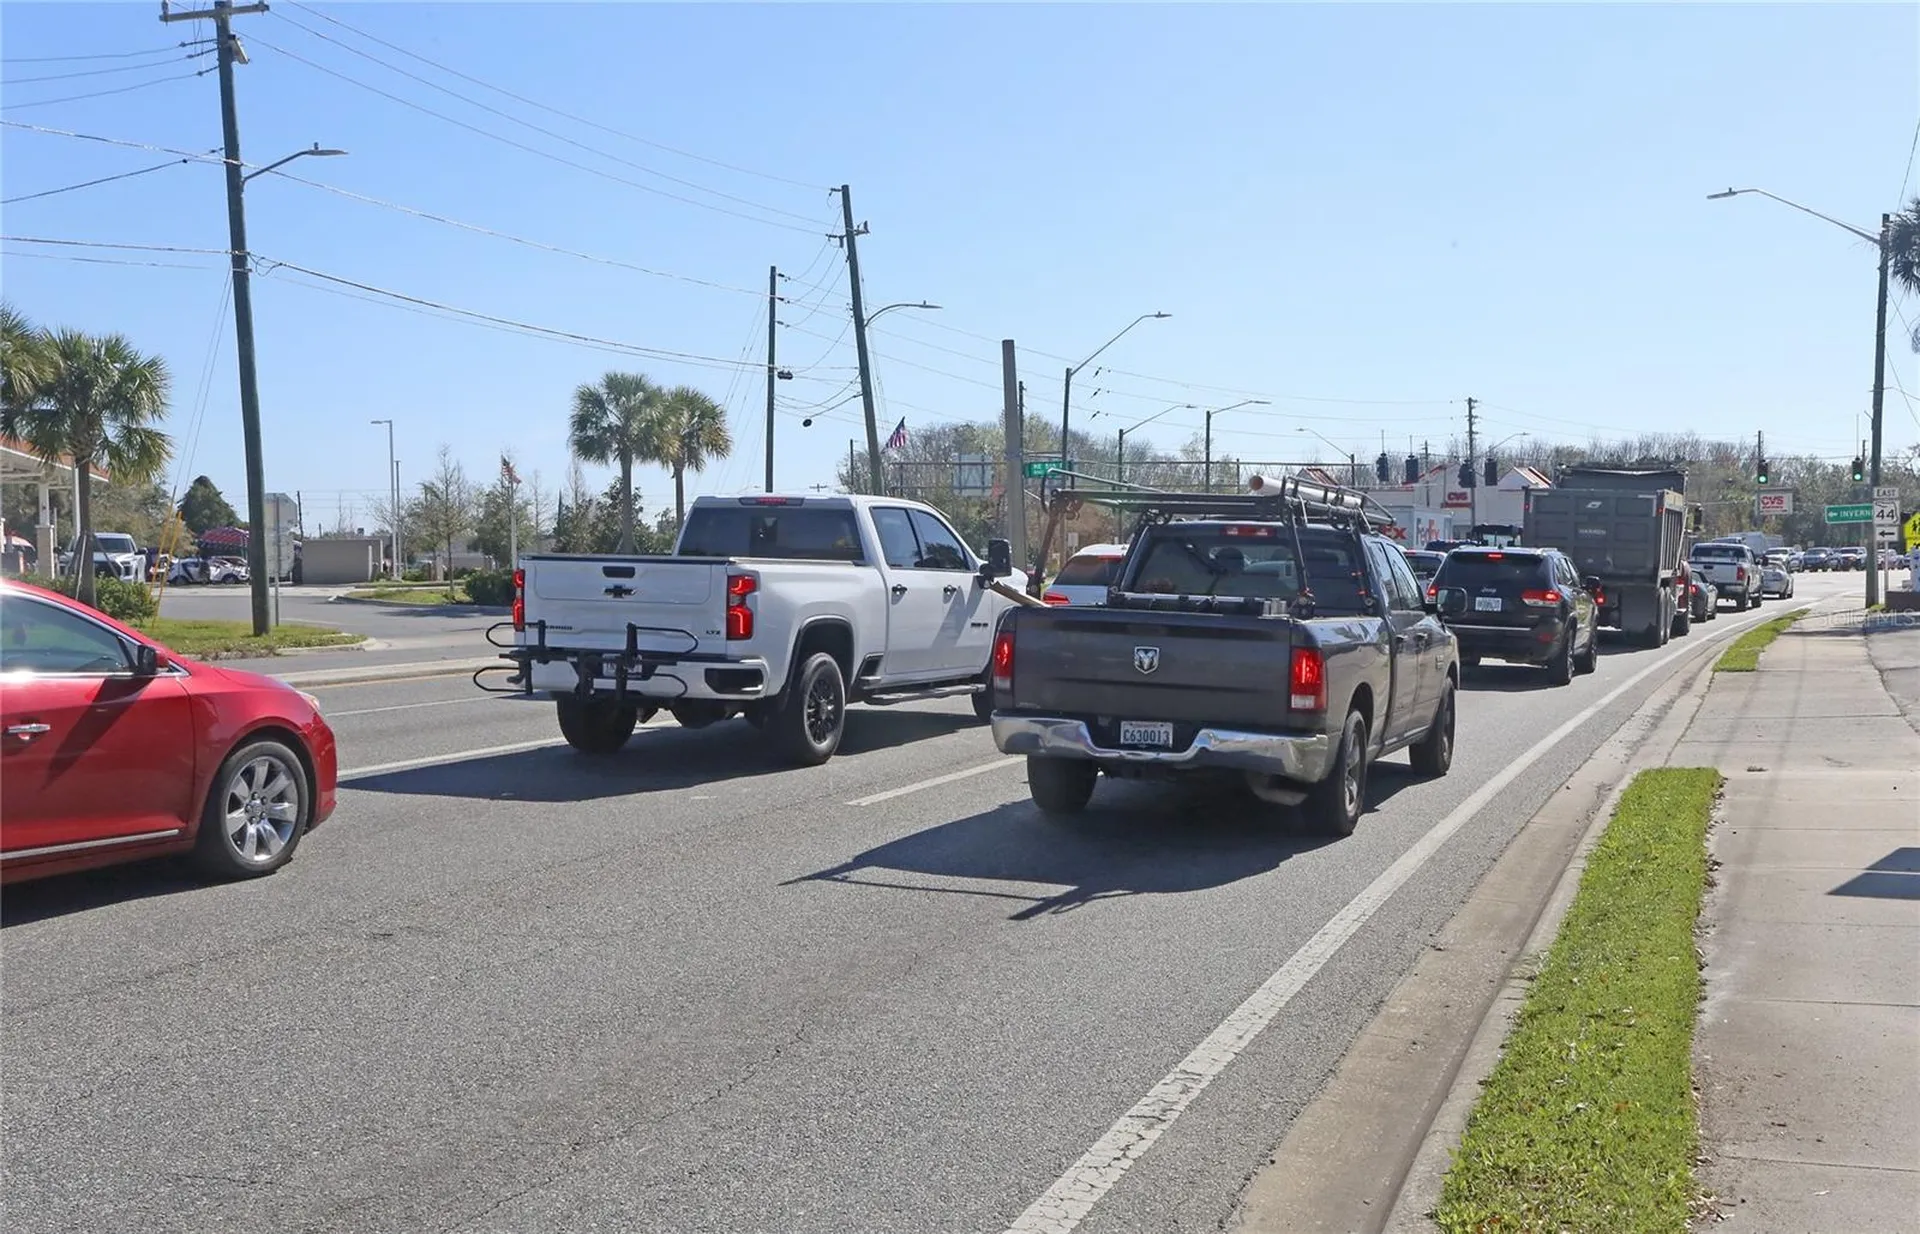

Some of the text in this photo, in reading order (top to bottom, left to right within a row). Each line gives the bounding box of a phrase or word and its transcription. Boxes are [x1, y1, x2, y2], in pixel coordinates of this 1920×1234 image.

[1447, 492, 1468, 501] CVS
[1877, 489, 1896, 497] EAST
[1761, 496, 1784, 506] CVS
[1876, 509, 1895, 520] 44
